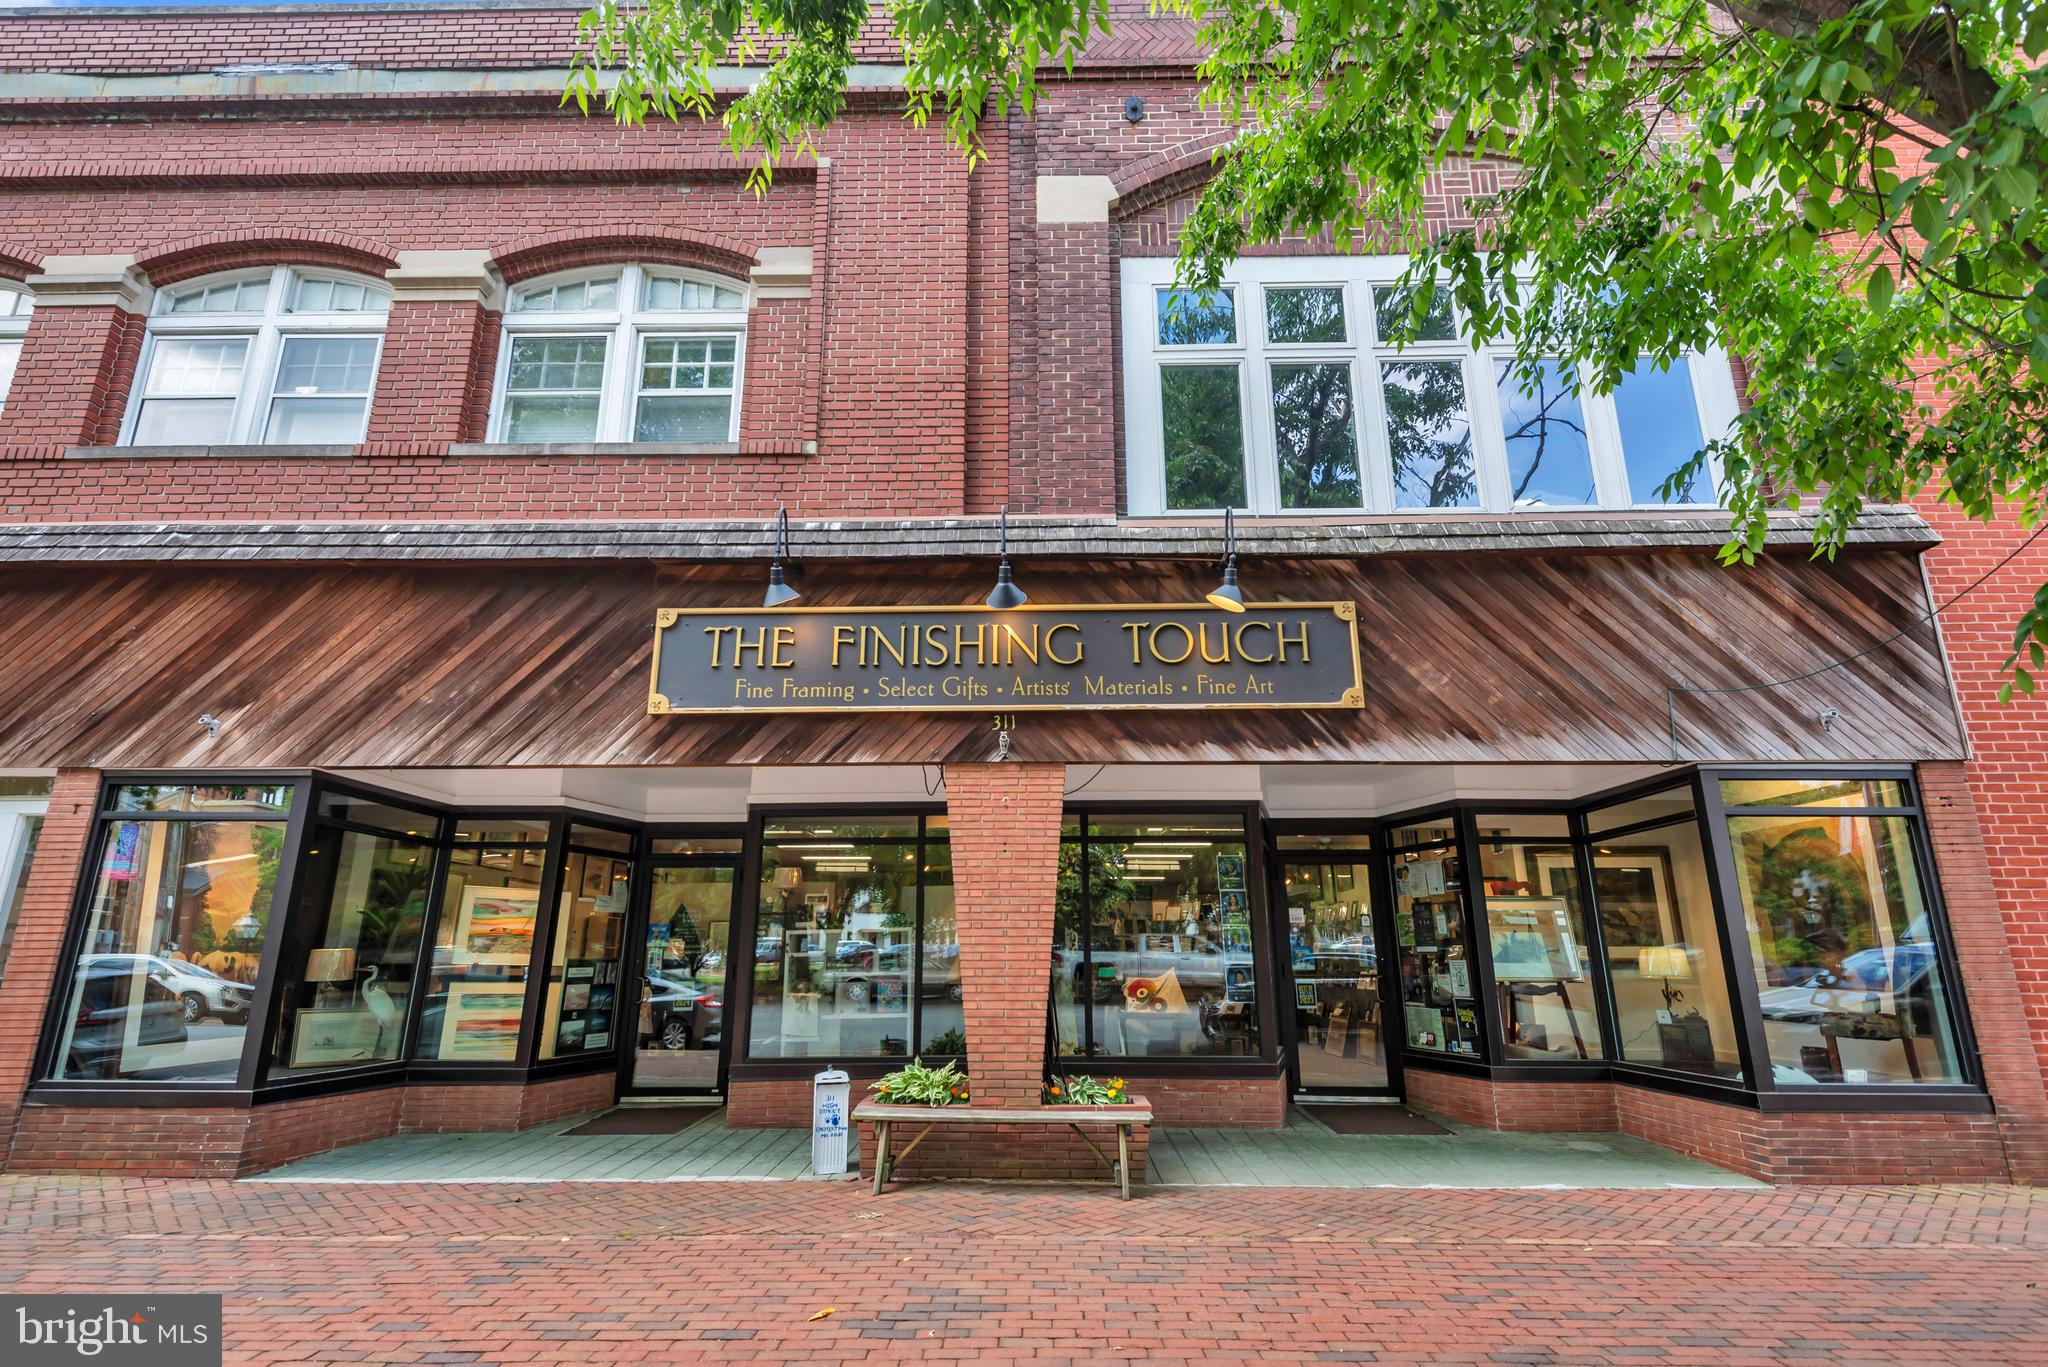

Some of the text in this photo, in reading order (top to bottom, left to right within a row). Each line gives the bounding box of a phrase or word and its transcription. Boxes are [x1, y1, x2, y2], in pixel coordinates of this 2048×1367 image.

[703, 621, 1311, 668] THE FINISHING TOUCH
[735, 674, 1274, 702] Fine Framing Select Gifts Artists' Materials Fine Art
[992, 714, 1016, 731] 311
